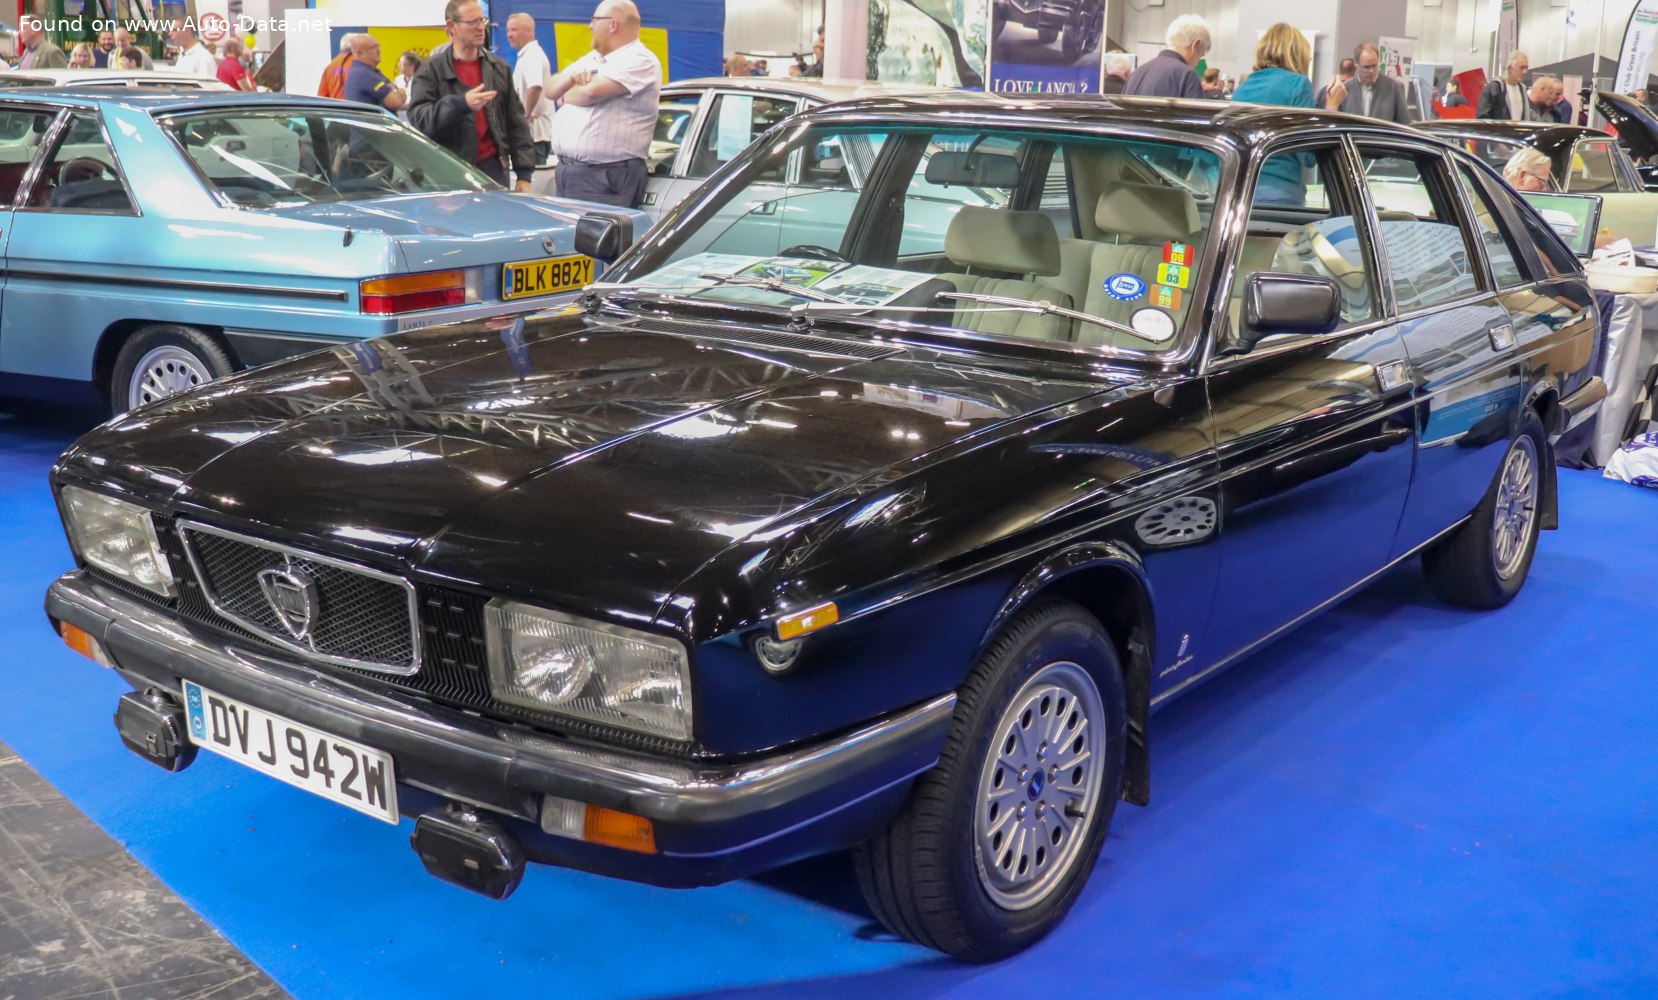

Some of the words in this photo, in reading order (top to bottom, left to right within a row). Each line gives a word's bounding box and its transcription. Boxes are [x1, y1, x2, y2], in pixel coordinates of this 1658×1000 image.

[1631, 30, 1641, 53] Britain
[993, 78, 1034, 93] LOVE
[1170, 253, 1185, 262] 06
[513, 265, 547, 293] BLK
[551, 259, 592, 288] 882Y
[1166, 273, 1180, 284] 03
[208, 695, 277, 766] DVJ
[285, 727, 387, 812] 942W
